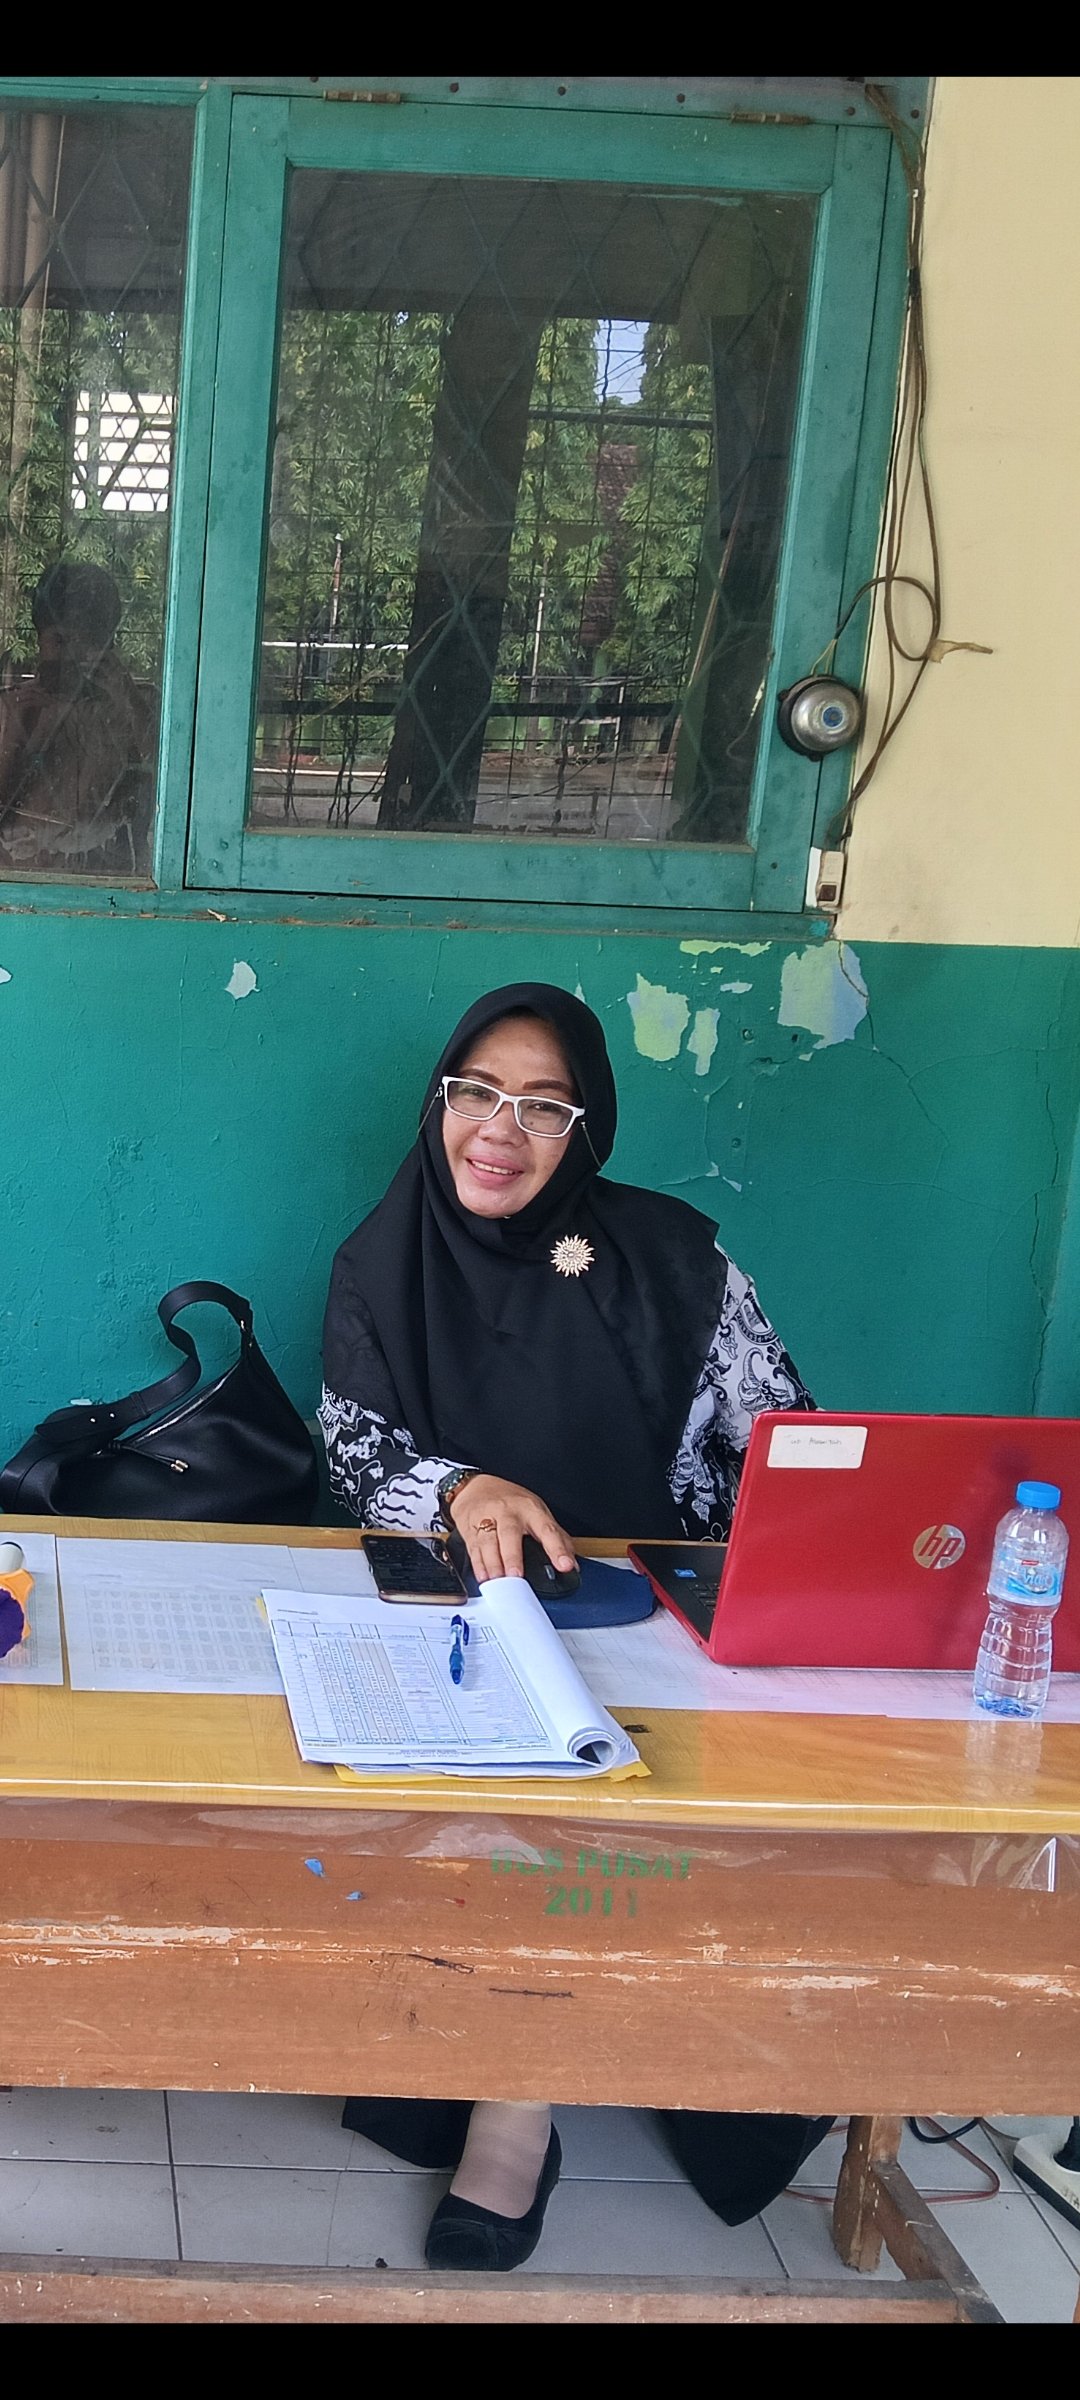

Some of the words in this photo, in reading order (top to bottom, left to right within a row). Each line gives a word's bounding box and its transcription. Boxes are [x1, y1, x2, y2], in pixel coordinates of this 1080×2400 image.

[917, 1523, 963, 1569] hp
[577, 1848, 695, 1880] PUSAT
[544, 1885, 638, 1917] 2011
